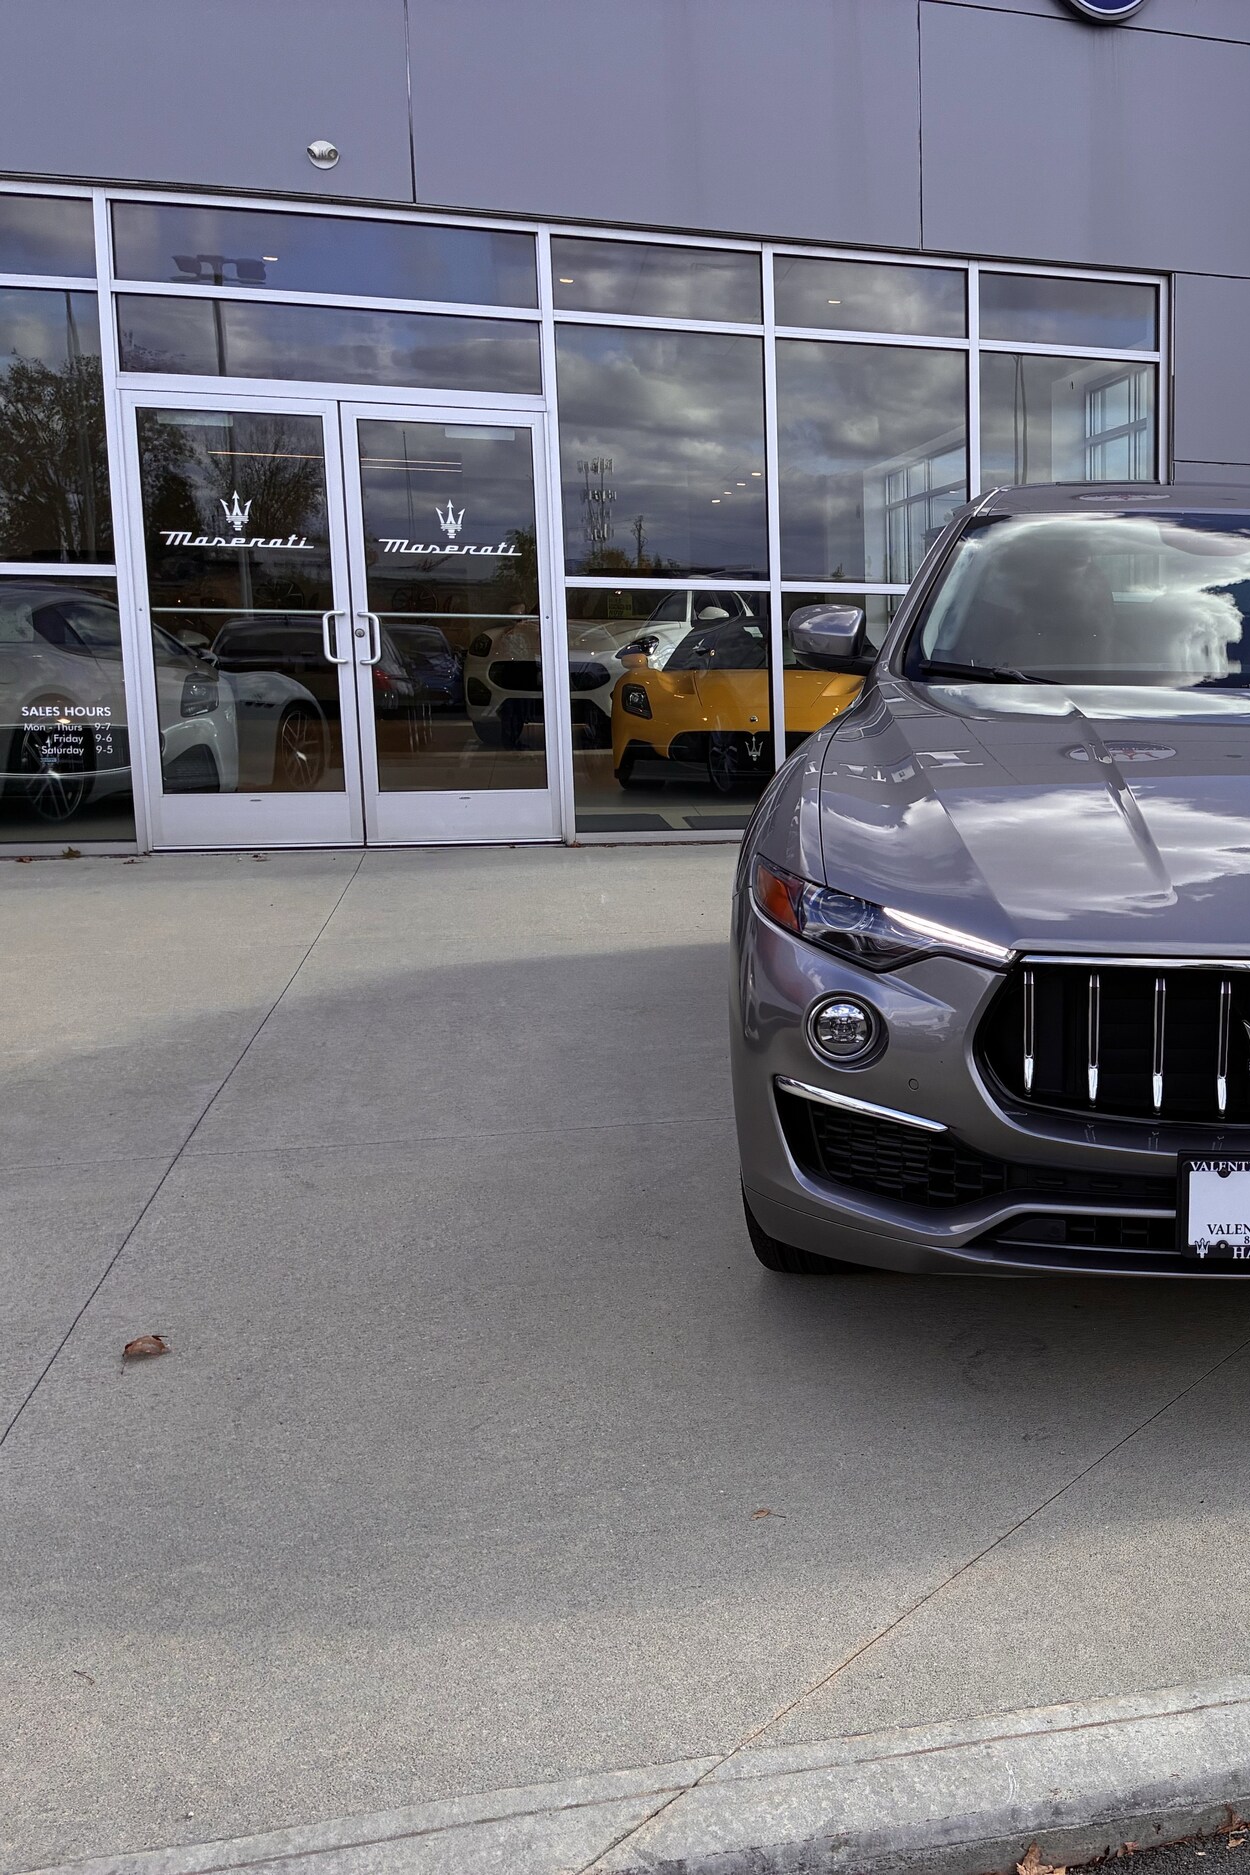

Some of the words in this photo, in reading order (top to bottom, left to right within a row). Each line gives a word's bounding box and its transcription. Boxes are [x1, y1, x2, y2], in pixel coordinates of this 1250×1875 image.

[159, 531, 315, 550] Maserati
[378, 538, 523, 556] Maserati
[21, 706, 60, 717] SALES
[64, 706, 112, 717] HOURS
[23, 723, 46, 732] Mon
[56, 723, 83, 732] Thurs
[94, 722, 111, 731] 9-7
[53, 734, 84, 744] Friday
[95, 734, 113, 743] 9-6
[41, 745, 85, 756] Saturday
[95, 745, 114, 754] 9-5
